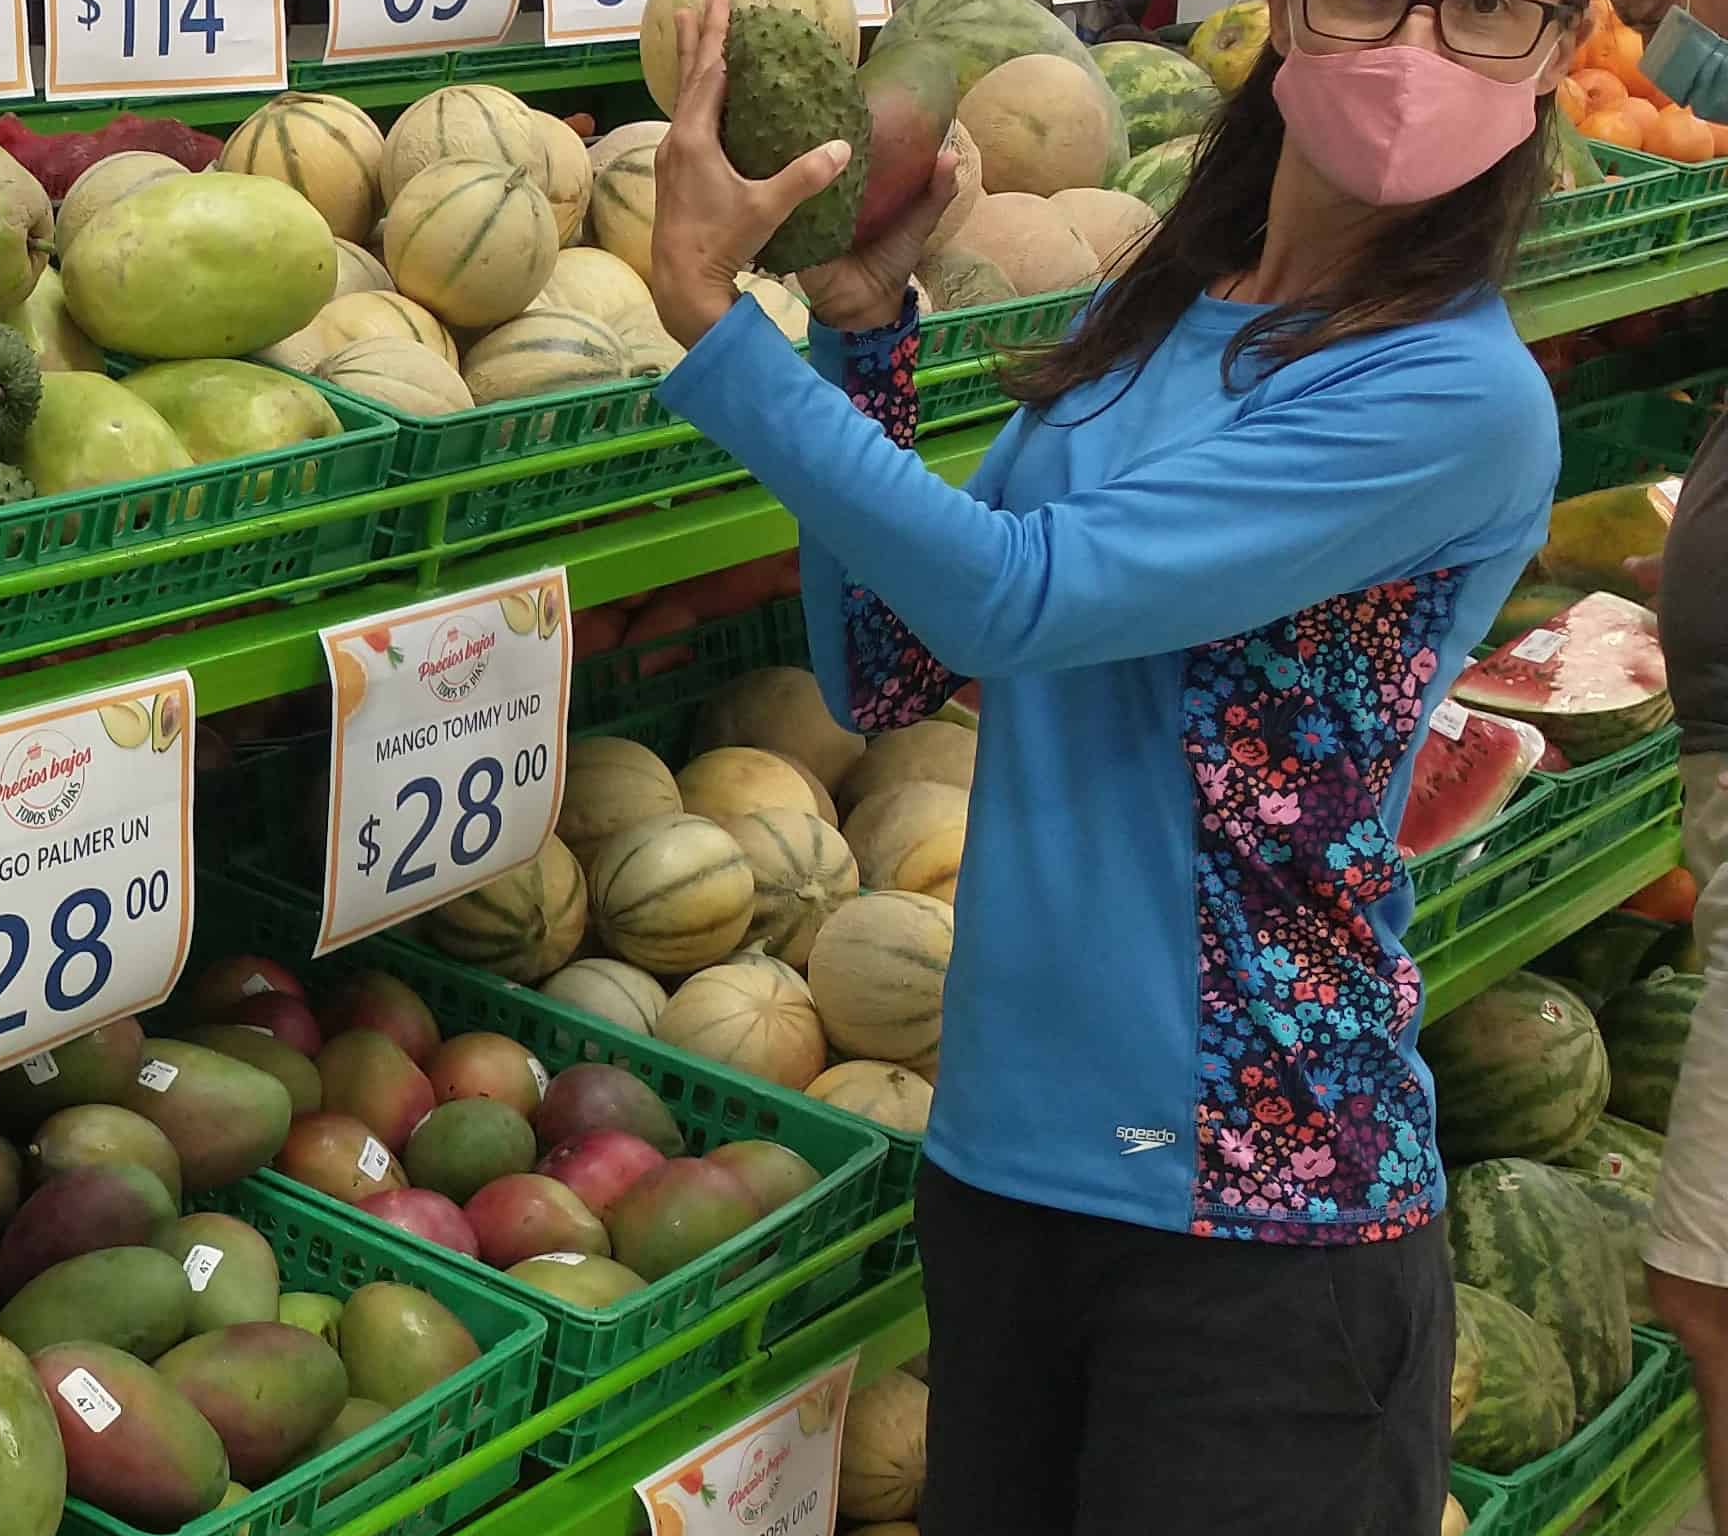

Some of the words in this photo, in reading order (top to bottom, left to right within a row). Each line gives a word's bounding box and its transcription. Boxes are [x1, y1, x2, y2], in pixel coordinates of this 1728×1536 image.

[375, 723, 439, 764] MANGO
[442, 705, 502, 742] TOMMY
[506, 693, 541, 723] UND
[49, 747, 92, 783] bajos
[357, 814, 381, 876] $
[385, 756, 504, 894] 28
[514, 743, 547, 788] 00
[37, 827, 116, 871] PALMER
[120, 815, 151, 845] UN
[126, 869, 169, 921] 00
[1116, 1126, 1176, 1144] speedo
[75, 1396, 96, 1413] 47
[792, 1489, 819, 1526] UND
